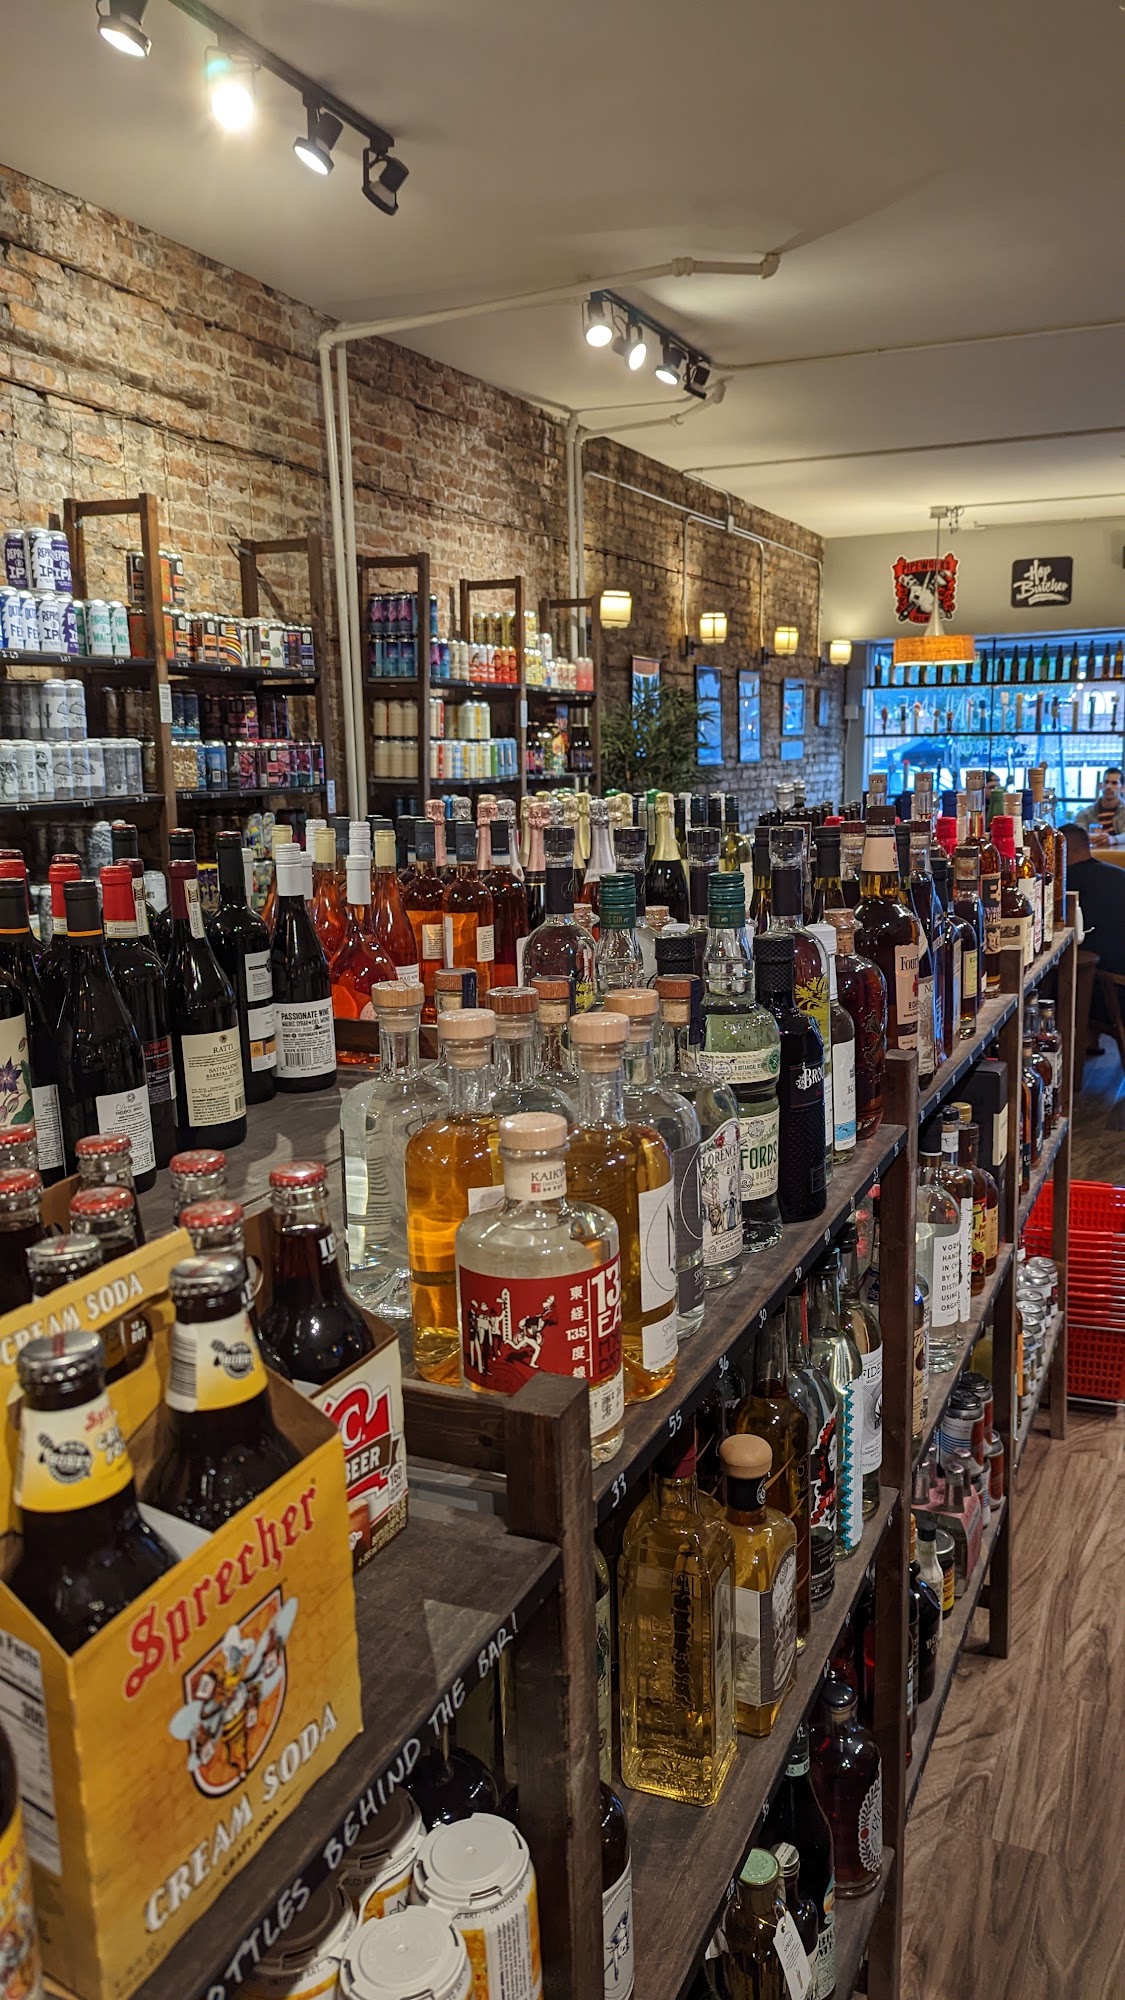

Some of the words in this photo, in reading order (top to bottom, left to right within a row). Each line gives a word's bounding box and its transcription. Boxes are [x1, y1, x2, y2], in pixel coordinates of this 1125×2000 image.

[1023, 559, 1052, 585] Hop
[1013, 578, 1069, 601] Butcher
[213, 1043, 234, 1054] RATTI
[740, 1140, 777, 1171] FORDS
[86, 1273, 144, 1321] SODA
[668, 1409, 683, 1438] 55
[610, 1471, 627, 1508] 33
[123, 1485, 317, 1700] Sprecher
[323, 1739, 422, 1869] BEHIND
[428, 1681, 467, 1737] THE
[477, 1611, 519, 1678] BAR!
[145, 1797, 253, 1934] CREAM
[263, 1702, 337, 1800] SODA
